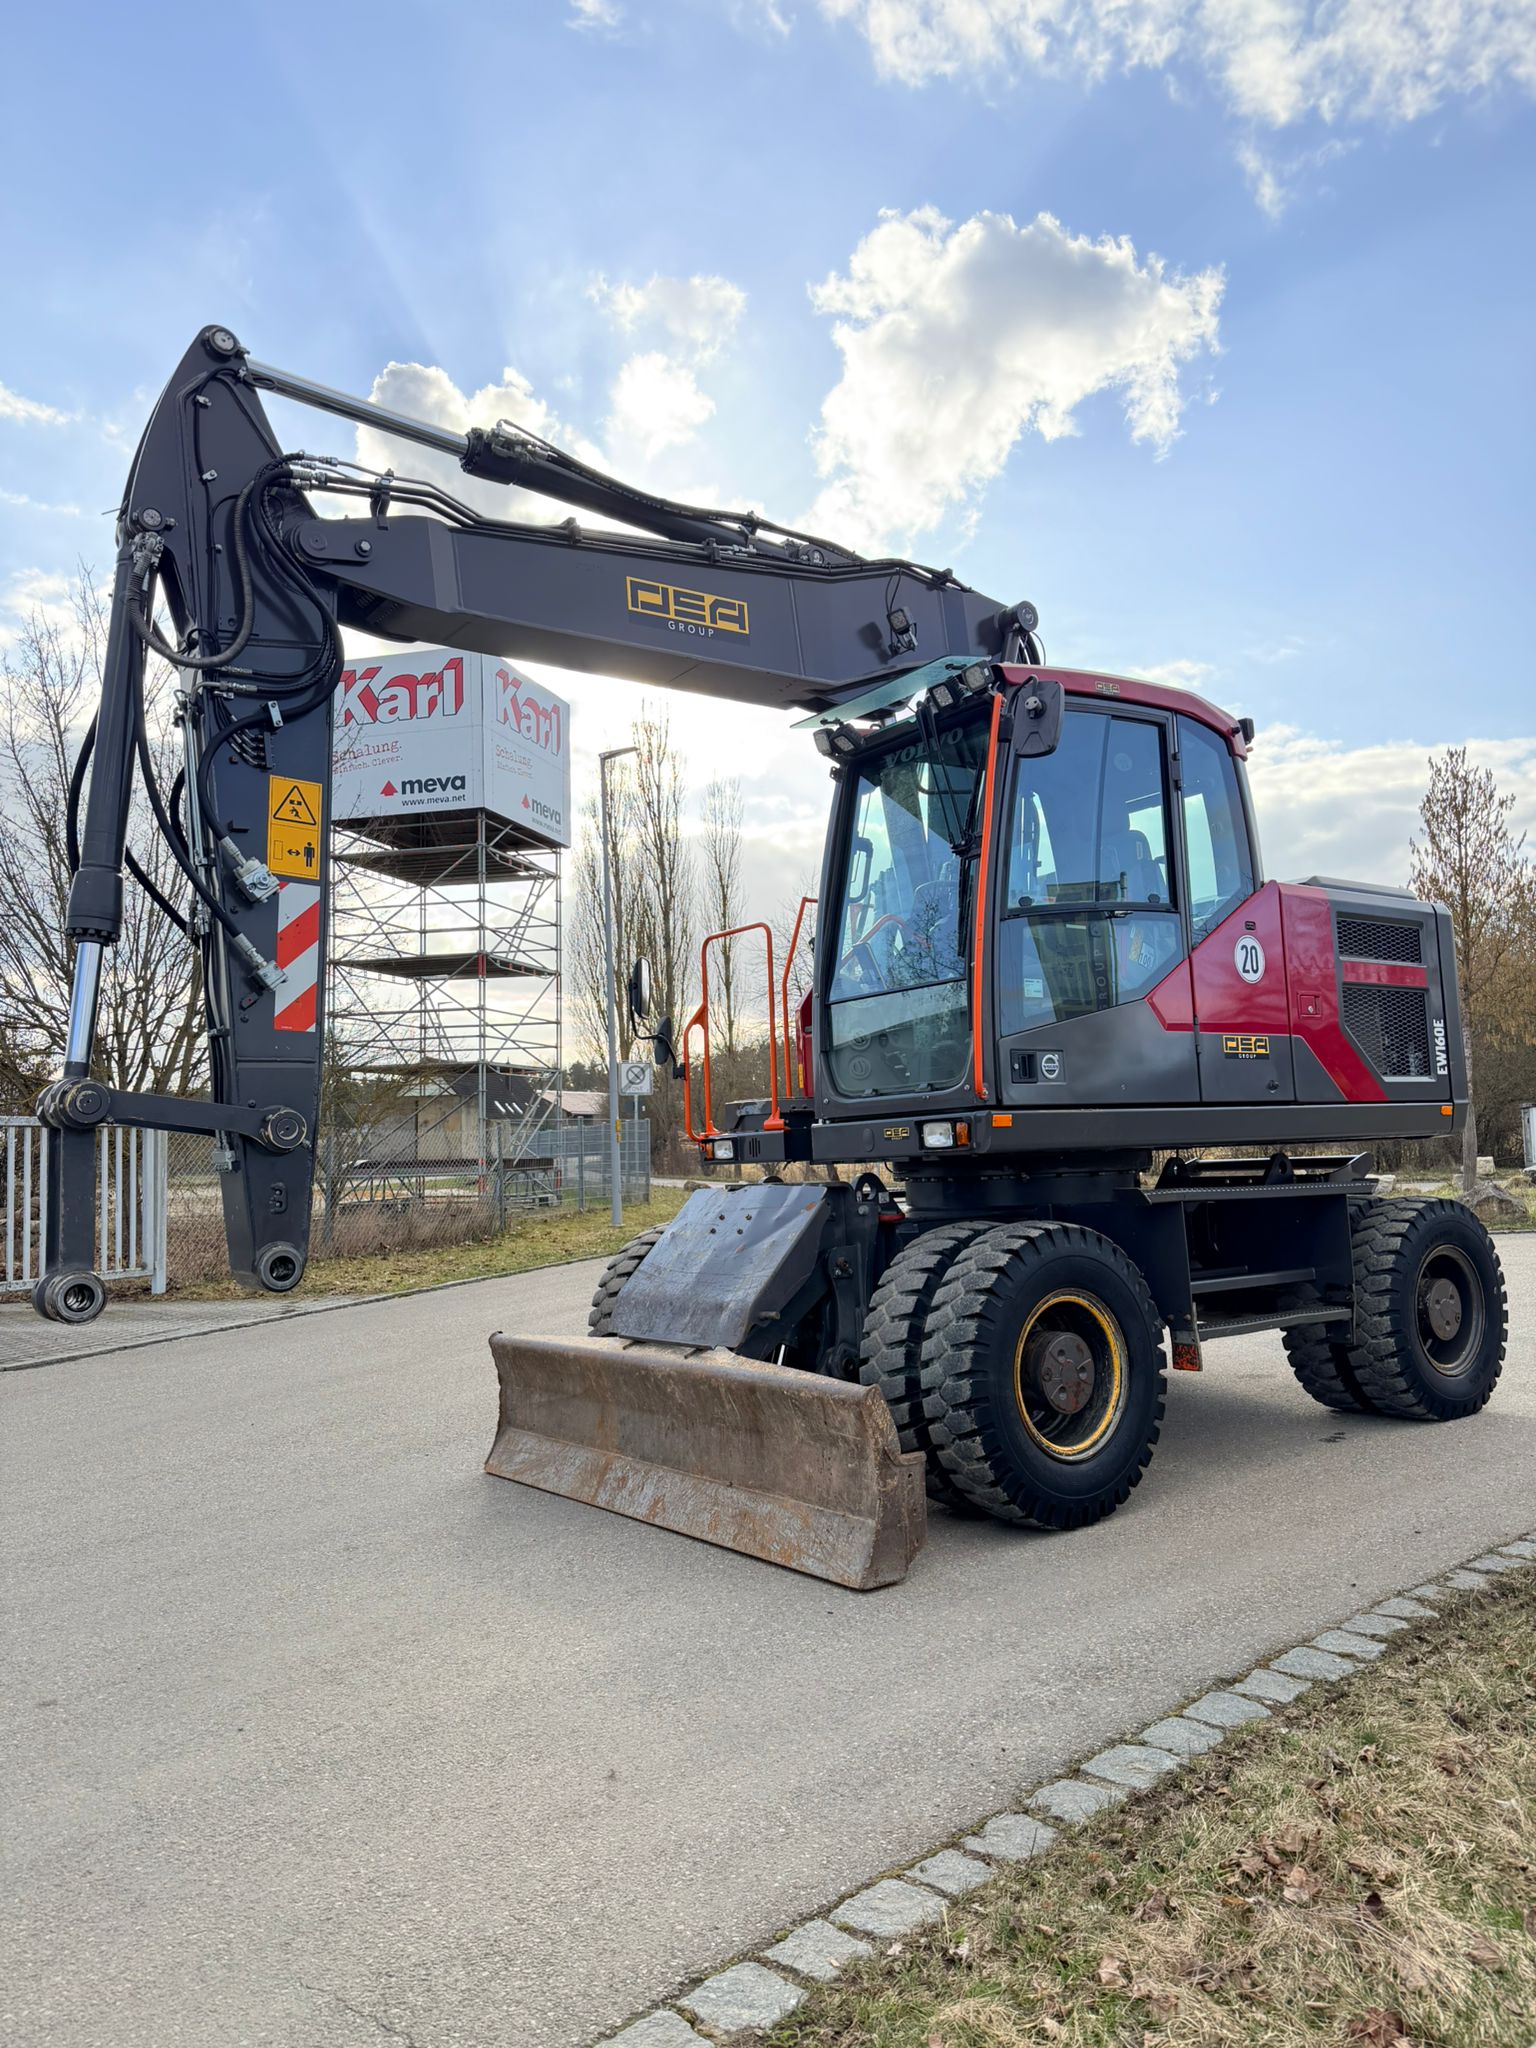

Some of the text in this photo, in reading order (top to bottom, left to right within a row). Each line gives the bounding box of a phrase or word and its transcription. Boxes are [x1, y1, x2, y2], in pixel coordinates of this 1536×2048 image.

[667, 620, 714, 638] GROUP
[332, 657, 464, 727] Karl
[496, 668, 561, 756] Karl
[401, 775, 466, 795] meva
[401, 794, 466, 807] www.meva.net
[531, 798, 562, 825] meva
[1240, 944, 1259, 974] 20
[1433, 1018, 1448, 1075] EW160E
